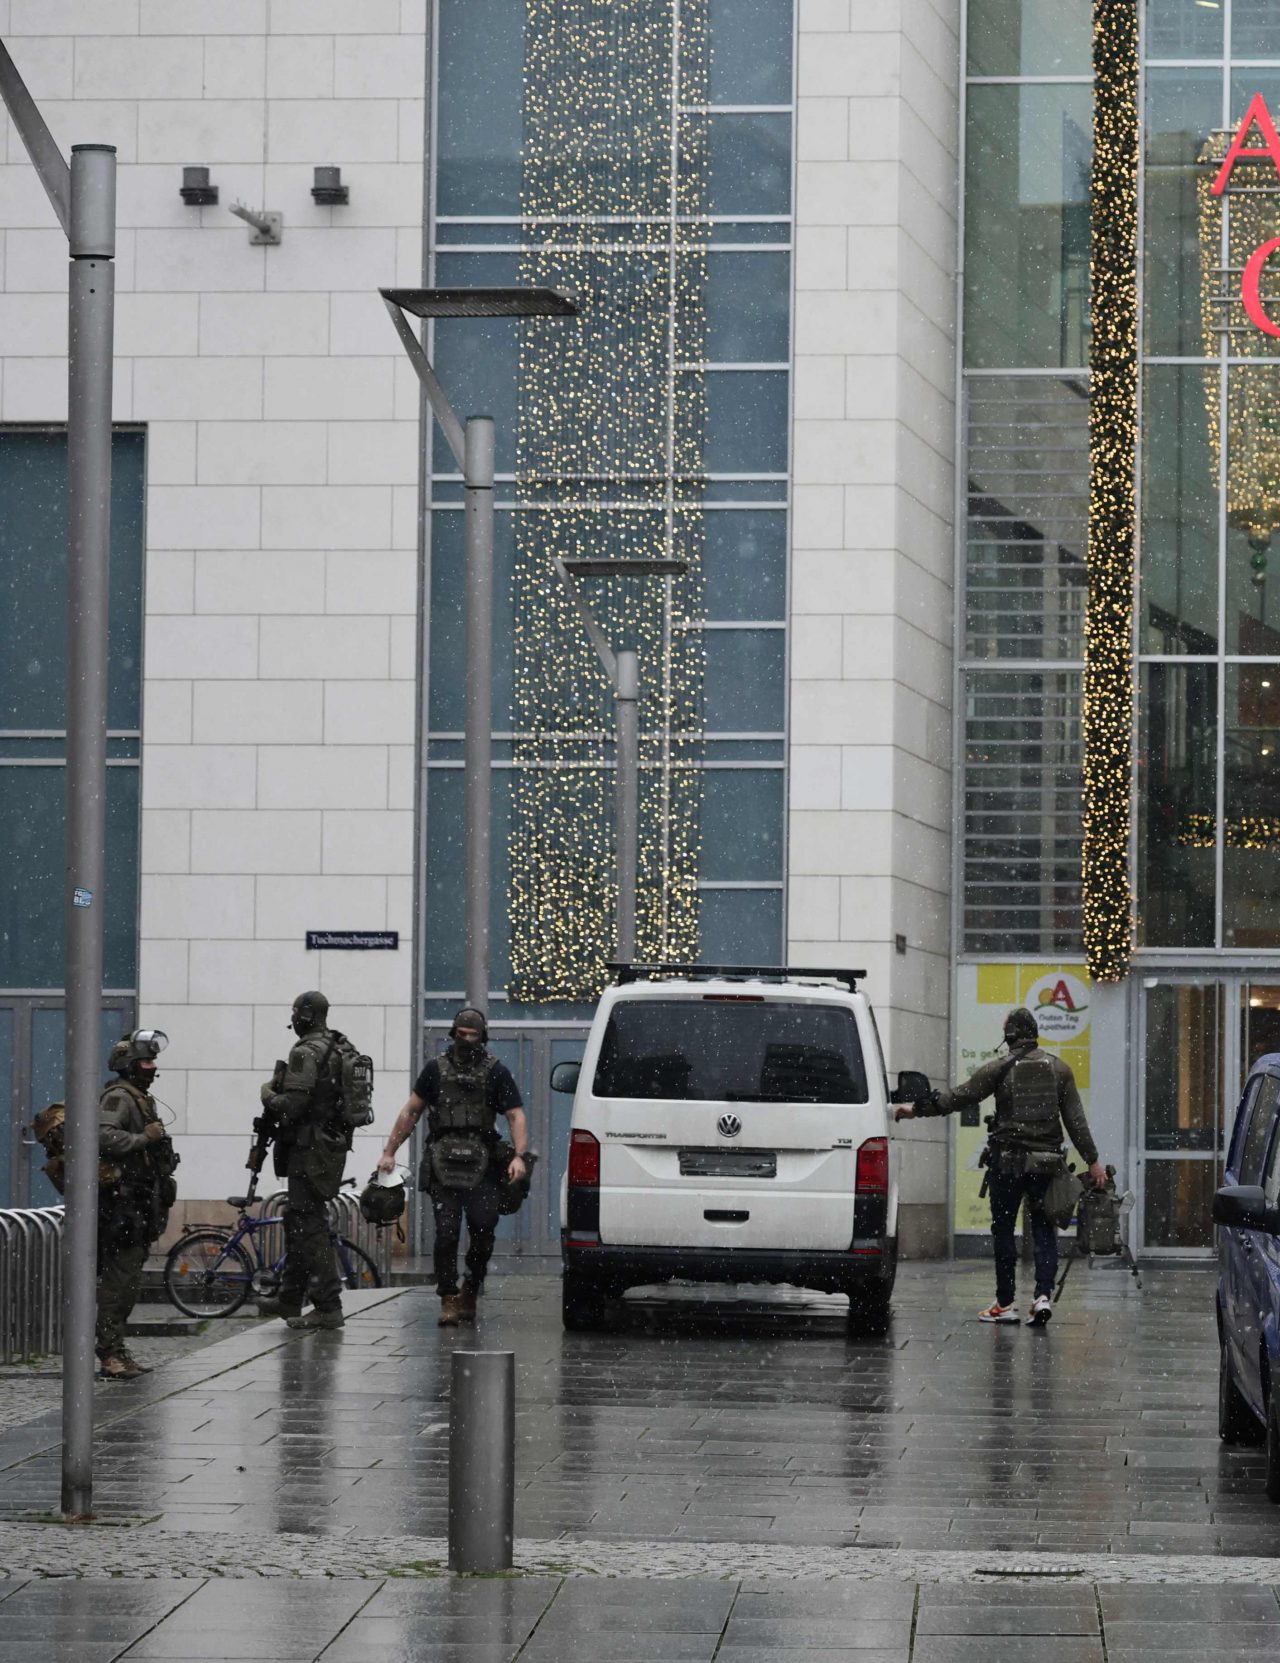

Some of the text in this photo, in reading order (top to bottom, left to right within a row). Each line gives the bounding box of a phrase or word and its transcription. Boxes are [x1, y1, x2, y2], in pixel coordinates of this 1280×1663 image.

[309, 933, 395, 947] Tuchmachergasse
[1065, 1014, 1079, 1023] Tag
[1038, 1023, 1077, 1031] Apotheke
[605, 1131, 667, 1139] TRANSPORTER
